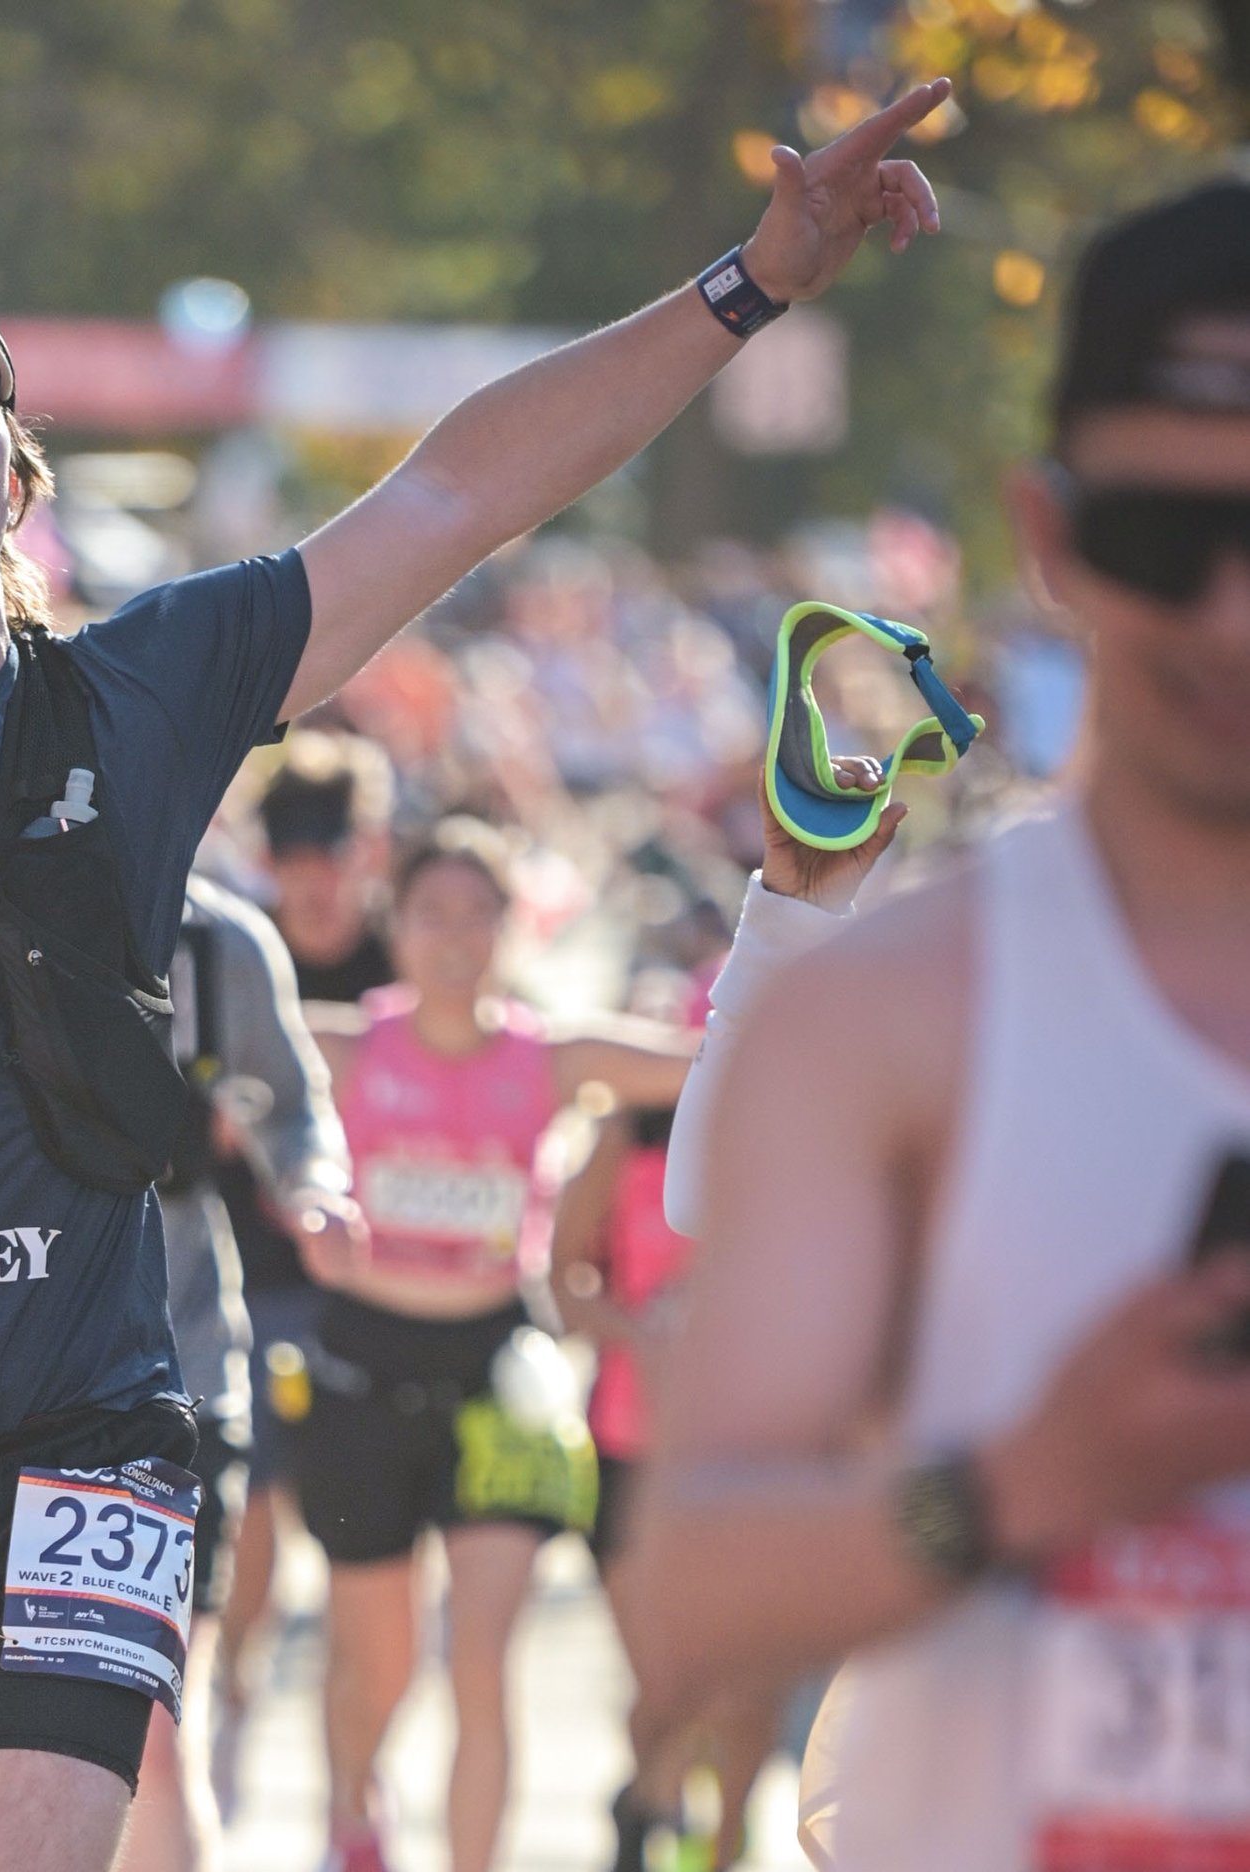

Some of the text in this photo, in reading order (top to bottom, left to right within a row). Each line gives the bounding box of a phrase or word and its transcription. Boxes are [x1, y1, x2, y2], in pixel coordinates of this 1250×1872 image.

[121, 1465, 175, 1497] CONSULTANCY
[18, 1570, 173, 1612] WAVE 2 BLUE CORRAL E
[34, 1636, 145, 1662] #TCSNYCMarathon
[108, 1663, 135, 1677] FERRY
